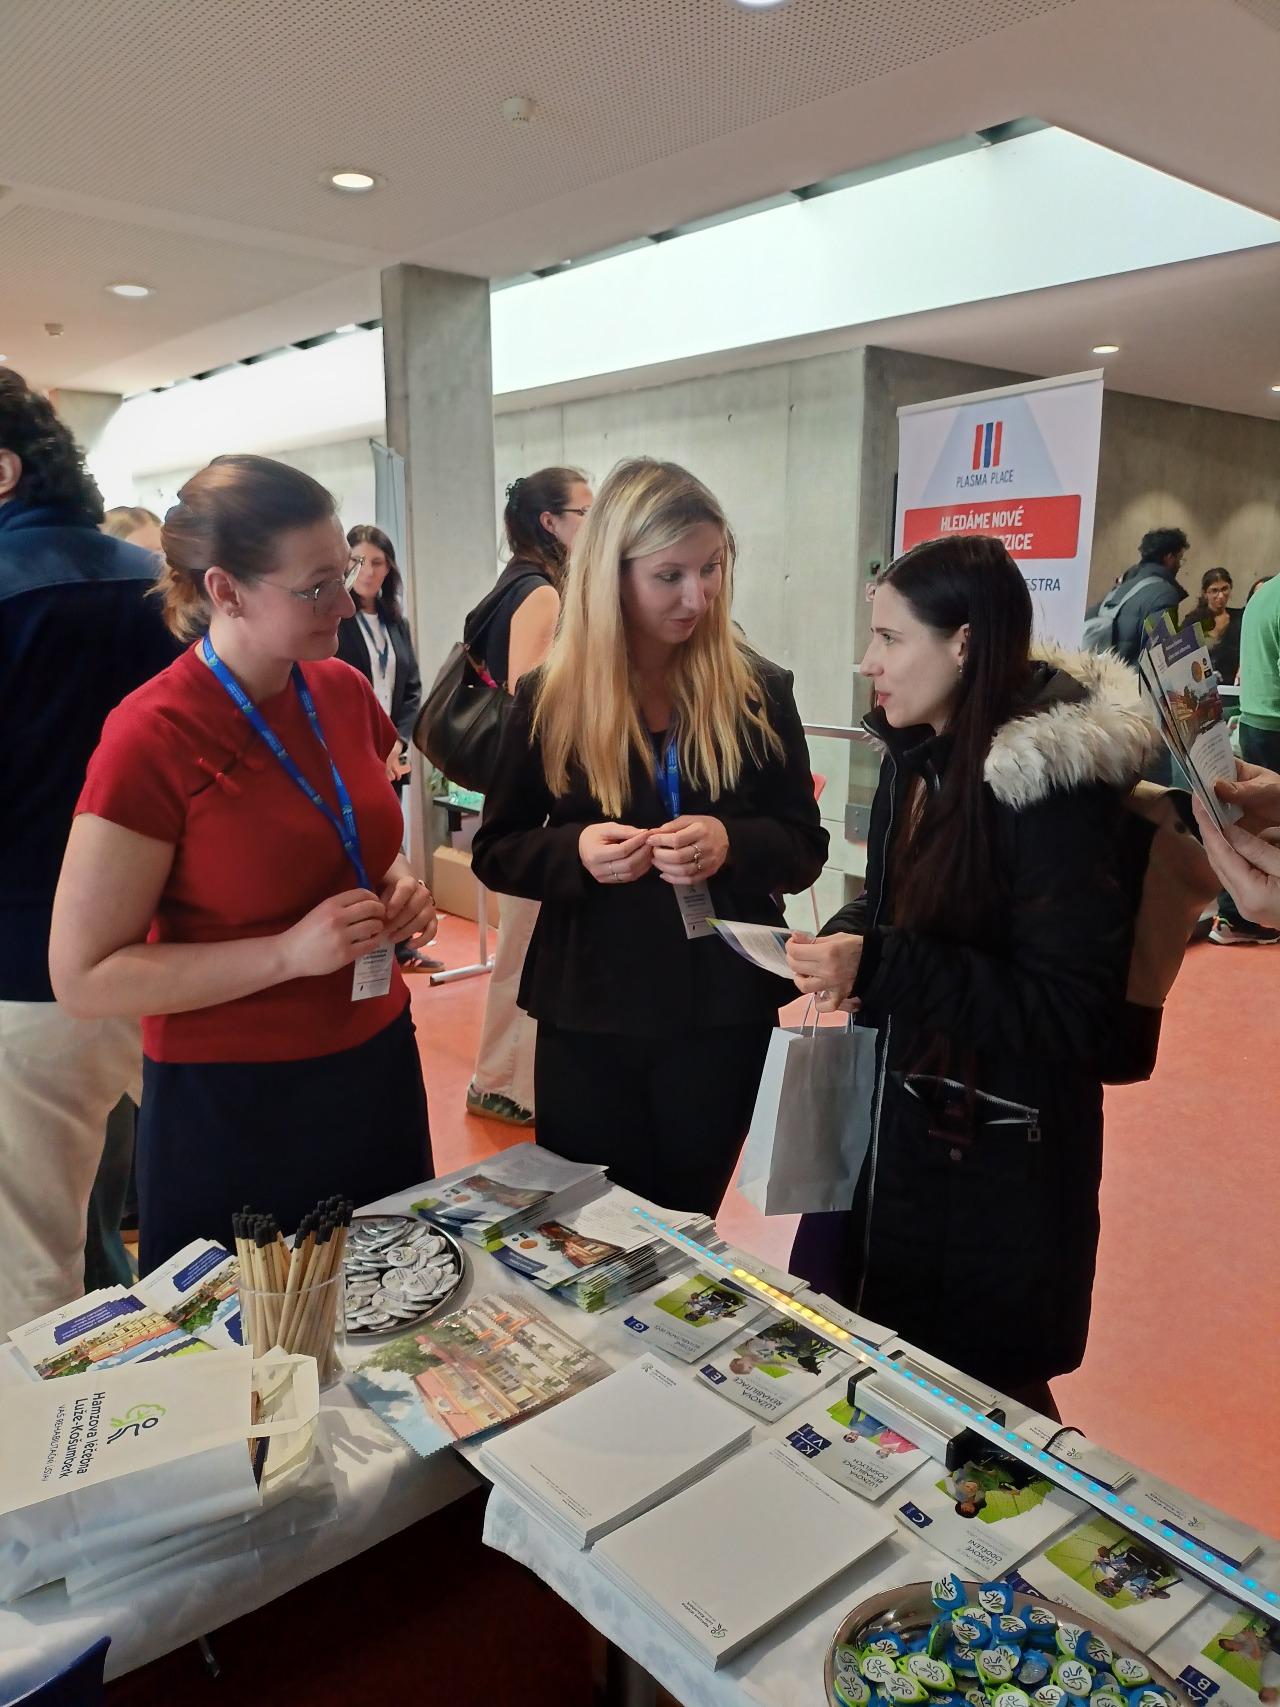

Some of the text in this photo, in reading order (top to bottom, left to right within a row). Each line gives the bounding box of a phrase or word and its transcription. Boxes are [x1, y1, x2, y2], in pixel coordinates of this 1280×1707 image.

[956, 469, 1014, 488] PLASMA PLACE
[940, 505, 1025, 532] HLEDÁME NOVÉ
[59, 1397, 89, 1479] Luže-Košumberk
[77, 1391, 106, 1475] Hamzova léčebna
[912, 1512, 925, 1523] C
[1197, 1678, 1212, 1691] B
